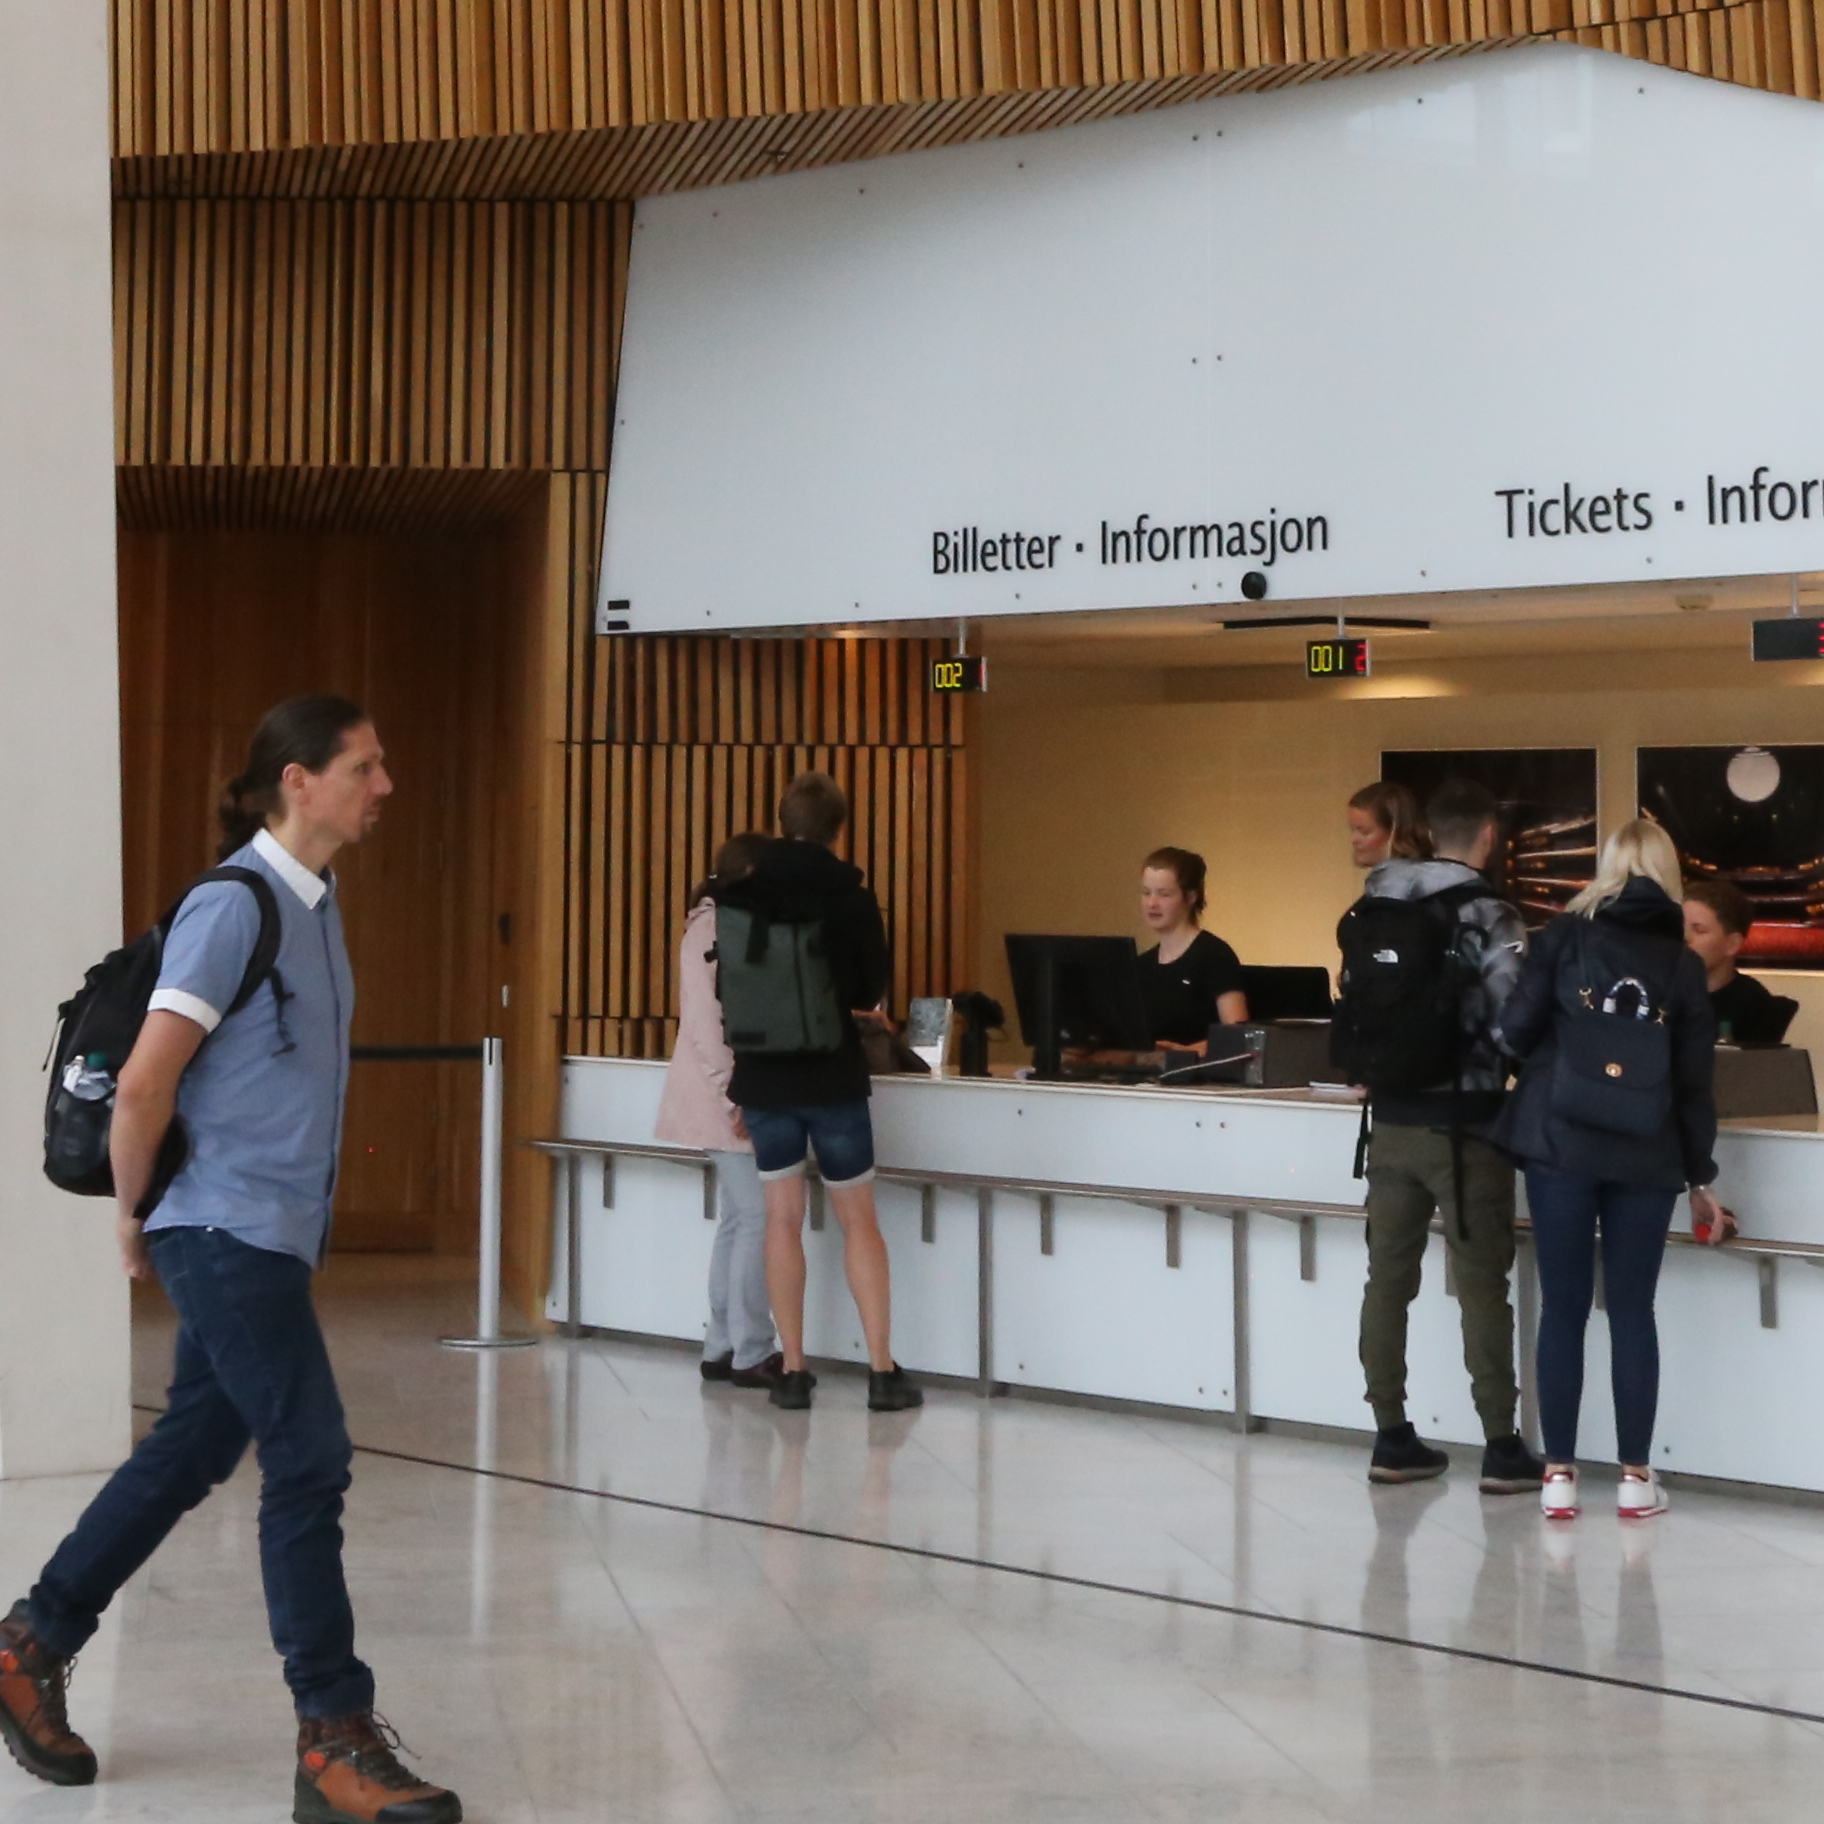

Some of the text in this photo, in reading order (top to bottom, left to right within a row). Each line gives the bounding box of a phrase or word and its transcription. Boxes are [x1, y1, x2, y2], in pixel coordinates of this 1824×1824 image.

[1495, 482, 1653, 539] Tickets
[932, 507, 1328, 575] Billetter Informasjon
[934, 662, 963, 688] 002
[1311, 645, 1343, 672] 001
